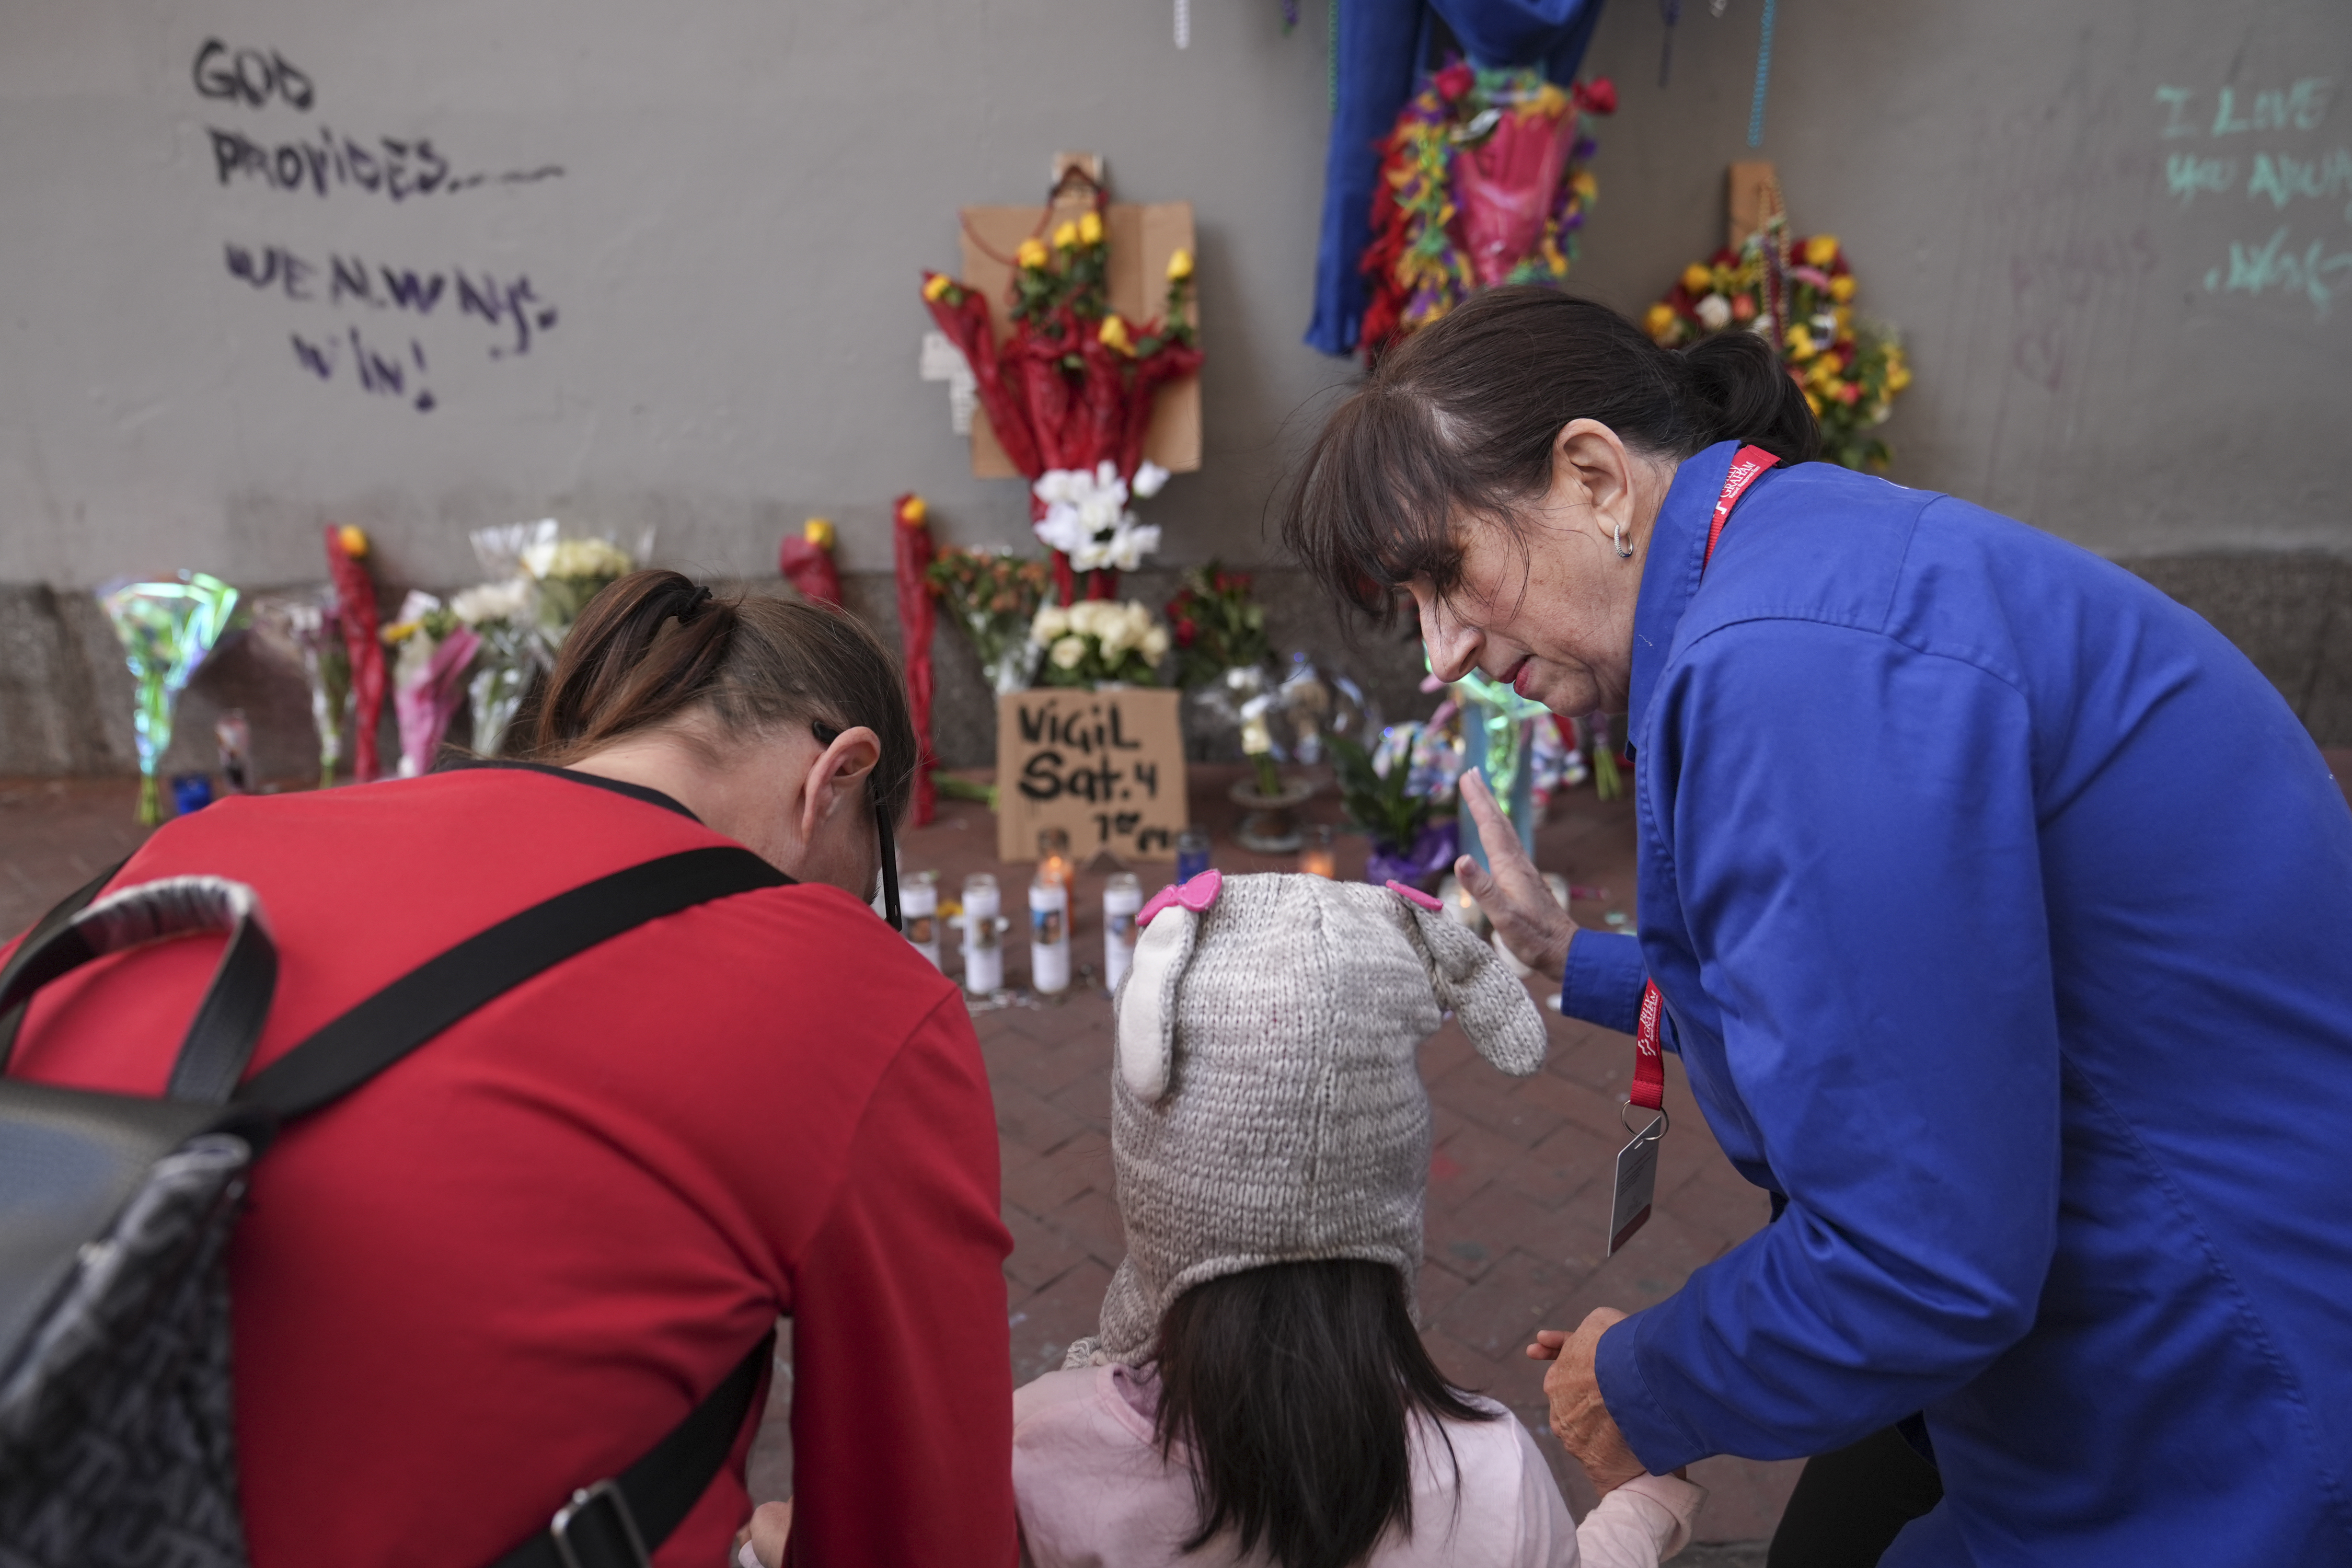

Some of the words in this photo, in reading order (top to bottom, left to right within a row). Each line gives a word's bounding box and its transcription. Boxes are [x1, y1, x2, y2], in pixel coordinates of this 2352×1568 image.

[193, 37, 315, 111] GOD
[2154, 84, 2193, 138] I
[2211, 76, 2332, 136] LOVE
[1720, 461, 1756, 498] GRAHAM
[1728, 487, 1740, 499] Rapid
[1737, 471, 1755, 487] Response
[1640, 993, 1651, 1024] BILLY
[1644, 989, 1656, 1039] GRAHAM
